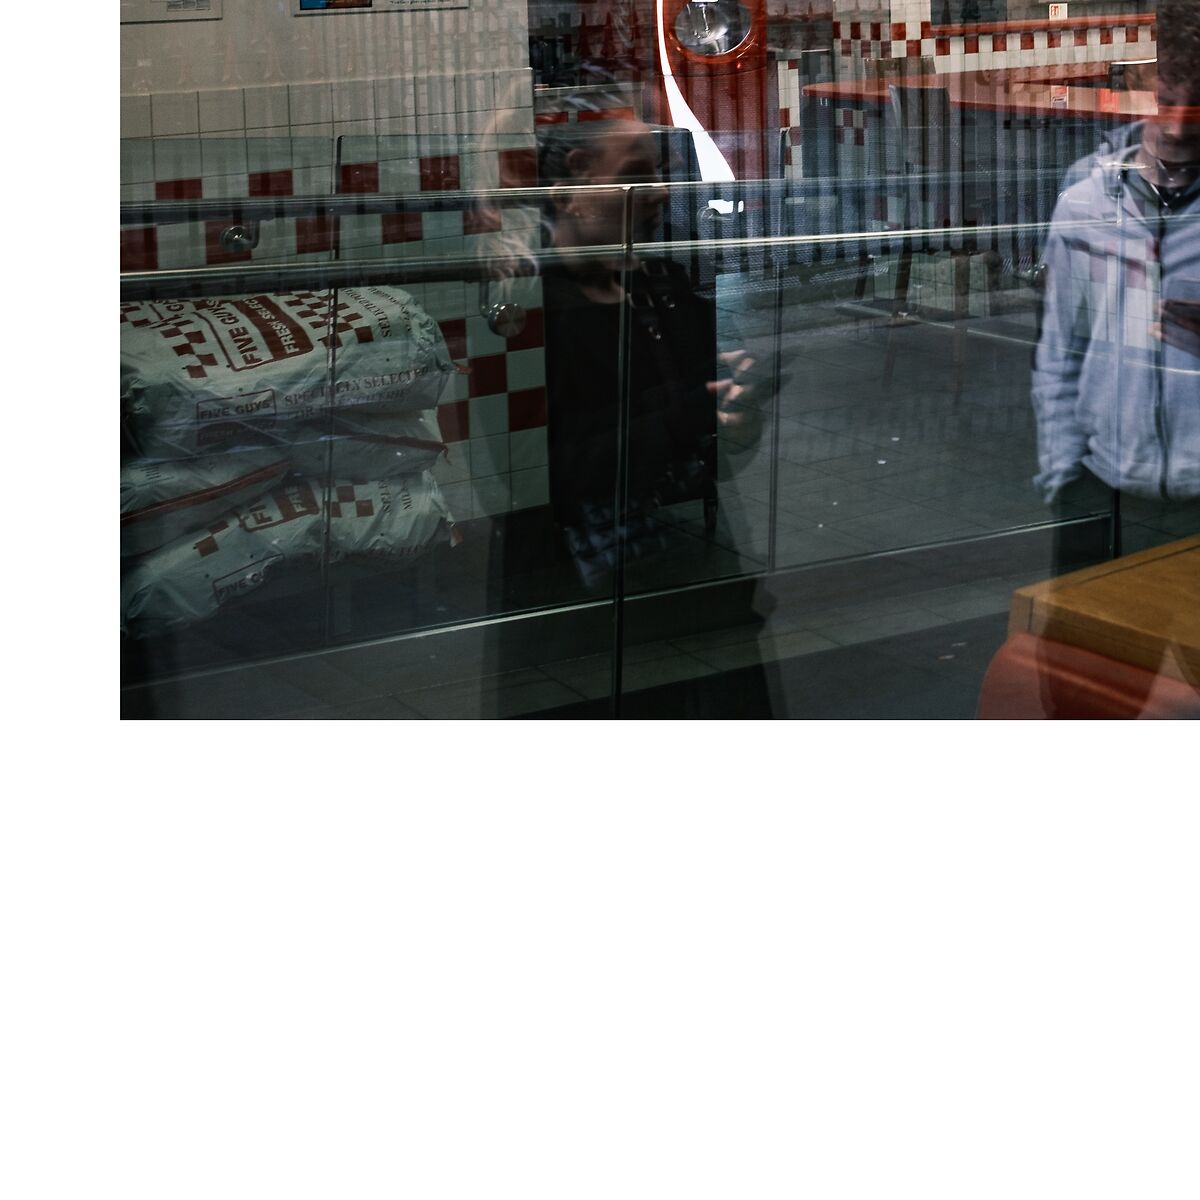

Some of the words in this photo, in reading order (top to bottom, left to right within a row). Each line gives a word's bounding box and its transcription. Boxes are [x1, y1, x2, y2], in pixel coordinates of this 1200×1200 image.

[228, 326, 264, 365] FIVE
[200, 405, 231, 423] FIVE
[233, 399, 272, 417] GUYS
